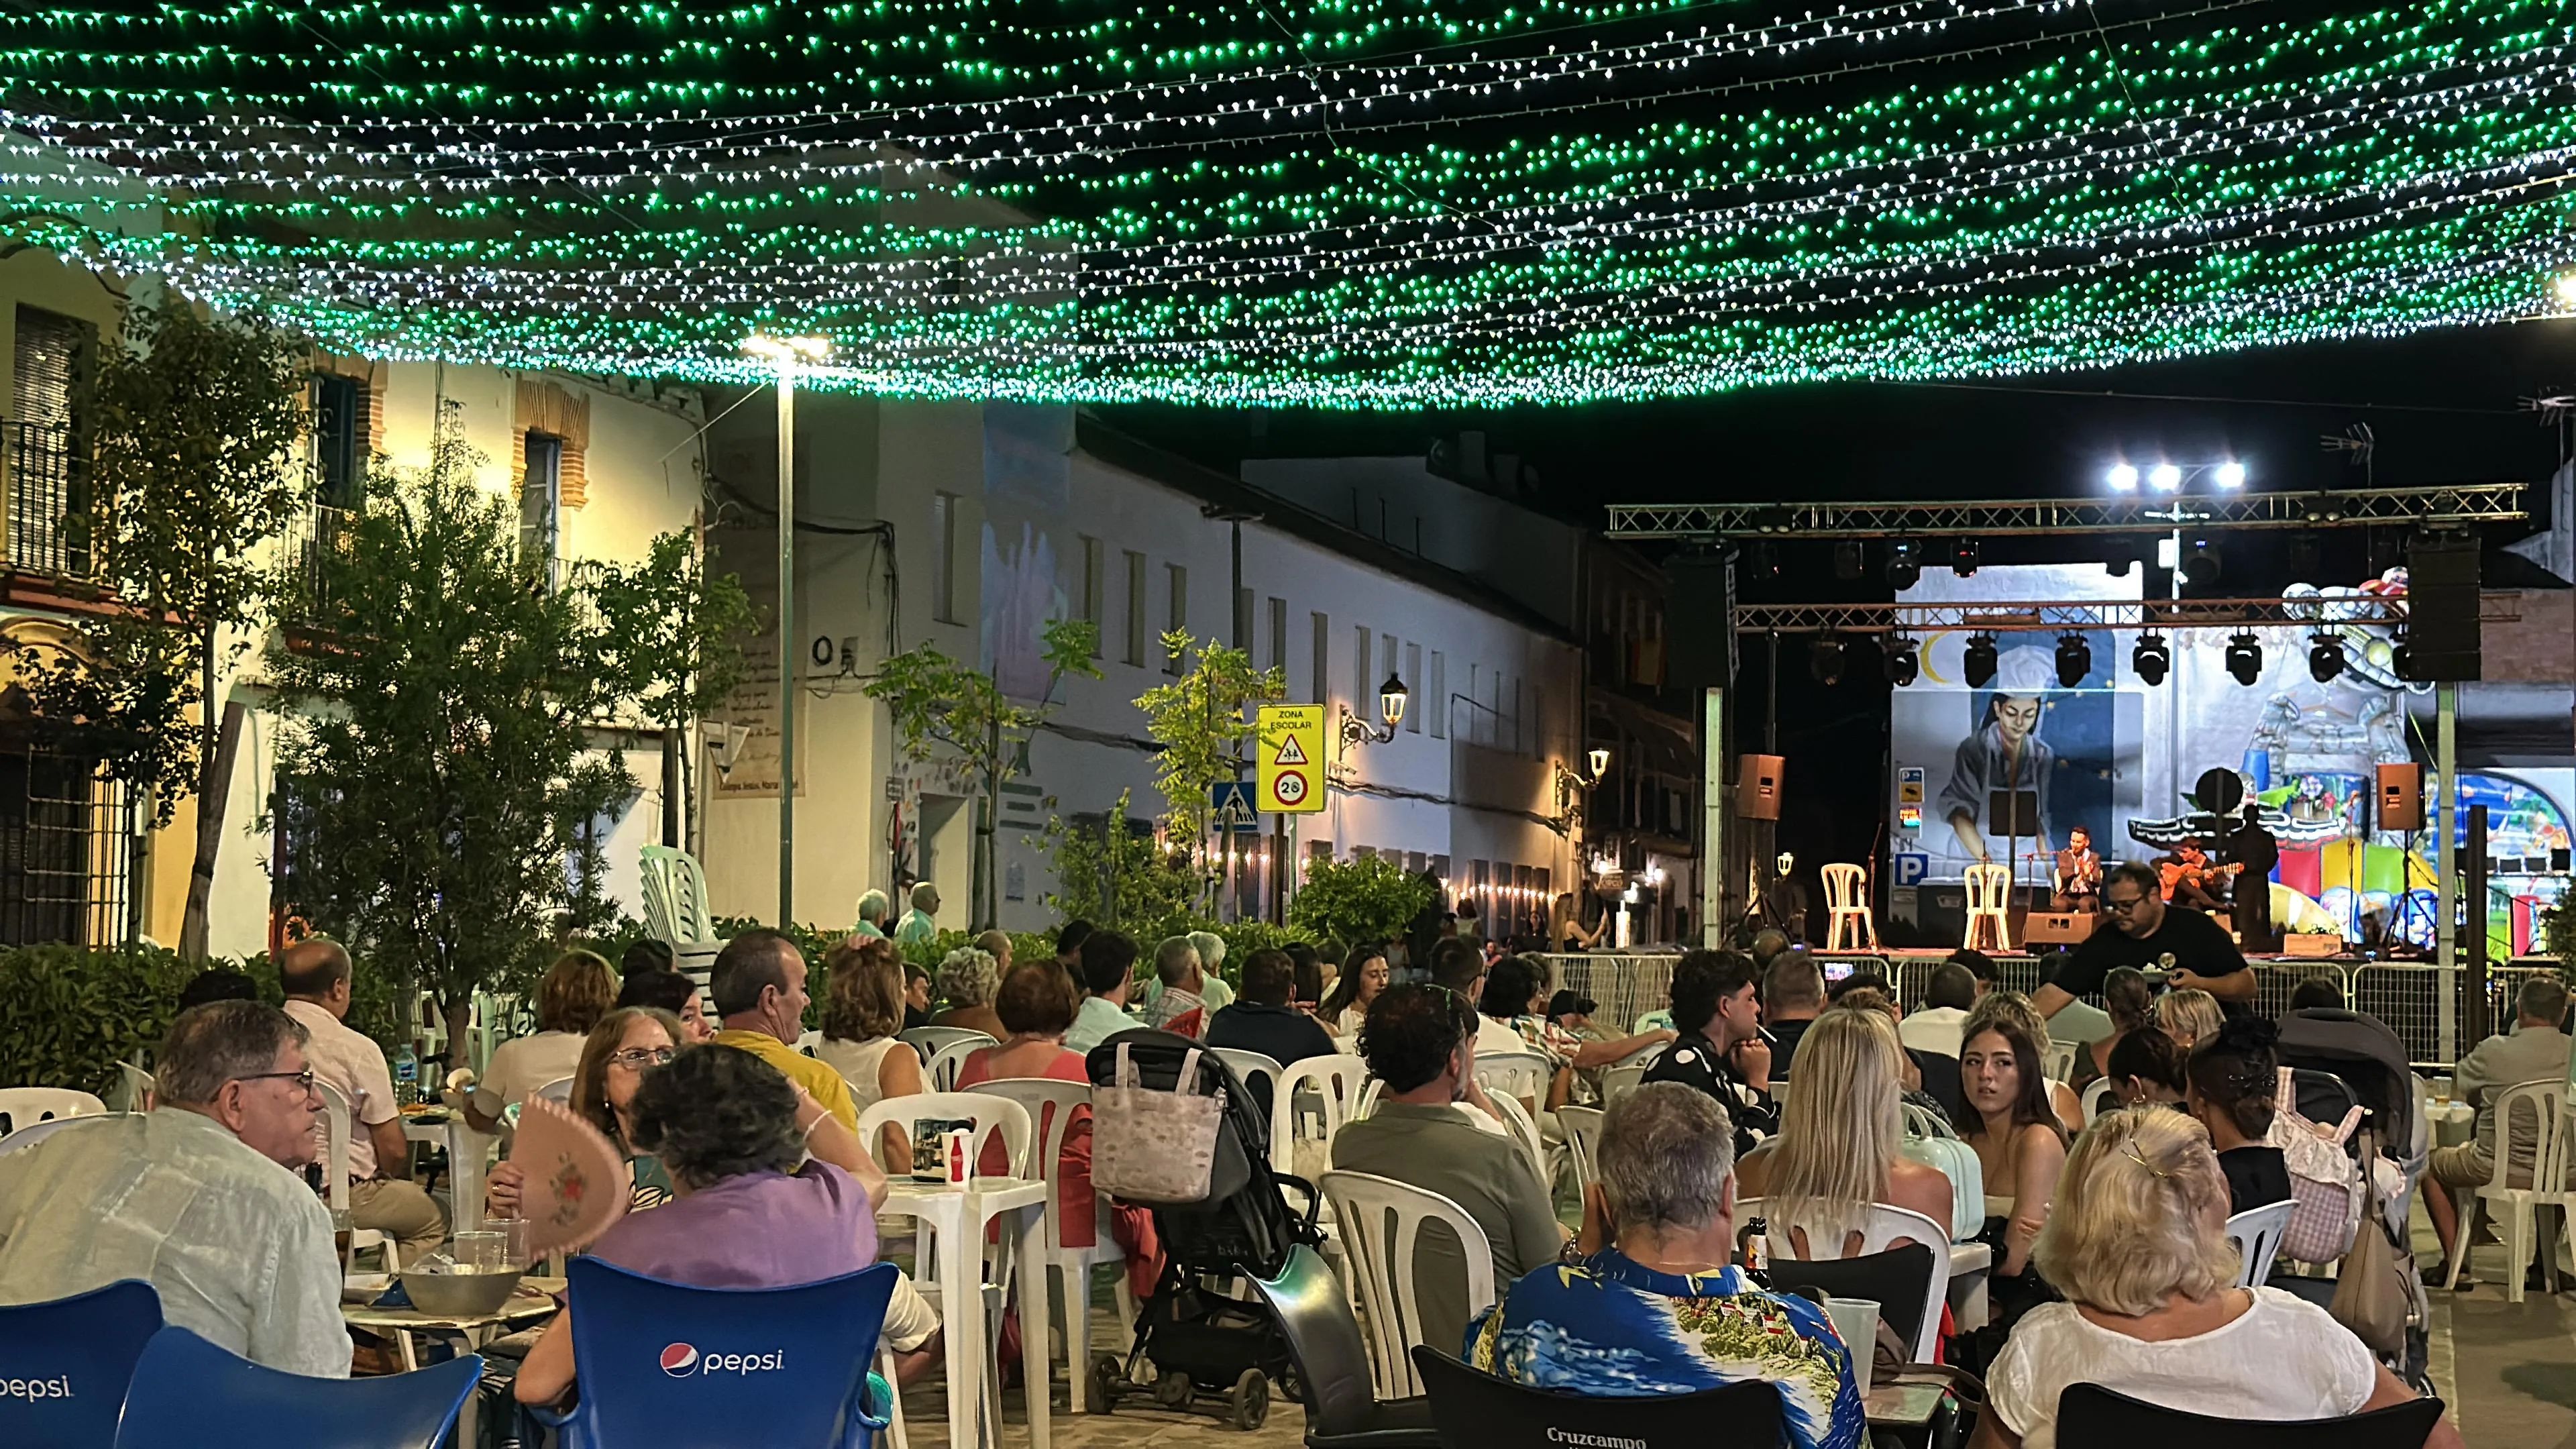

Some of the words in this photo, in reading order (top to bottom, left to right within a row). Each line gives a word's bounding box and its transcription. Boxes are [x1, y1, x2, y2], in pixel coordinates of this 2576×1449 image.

[1271, 721, 1312, 730] ESCOLAR
[1279, 710, 1303, 718] ZONA
[1900, 856, 1923, 884] P
[704, 1348, 783, 1376] pepsi
[1547, 1426, 1646, 1449] Cruzcampo
